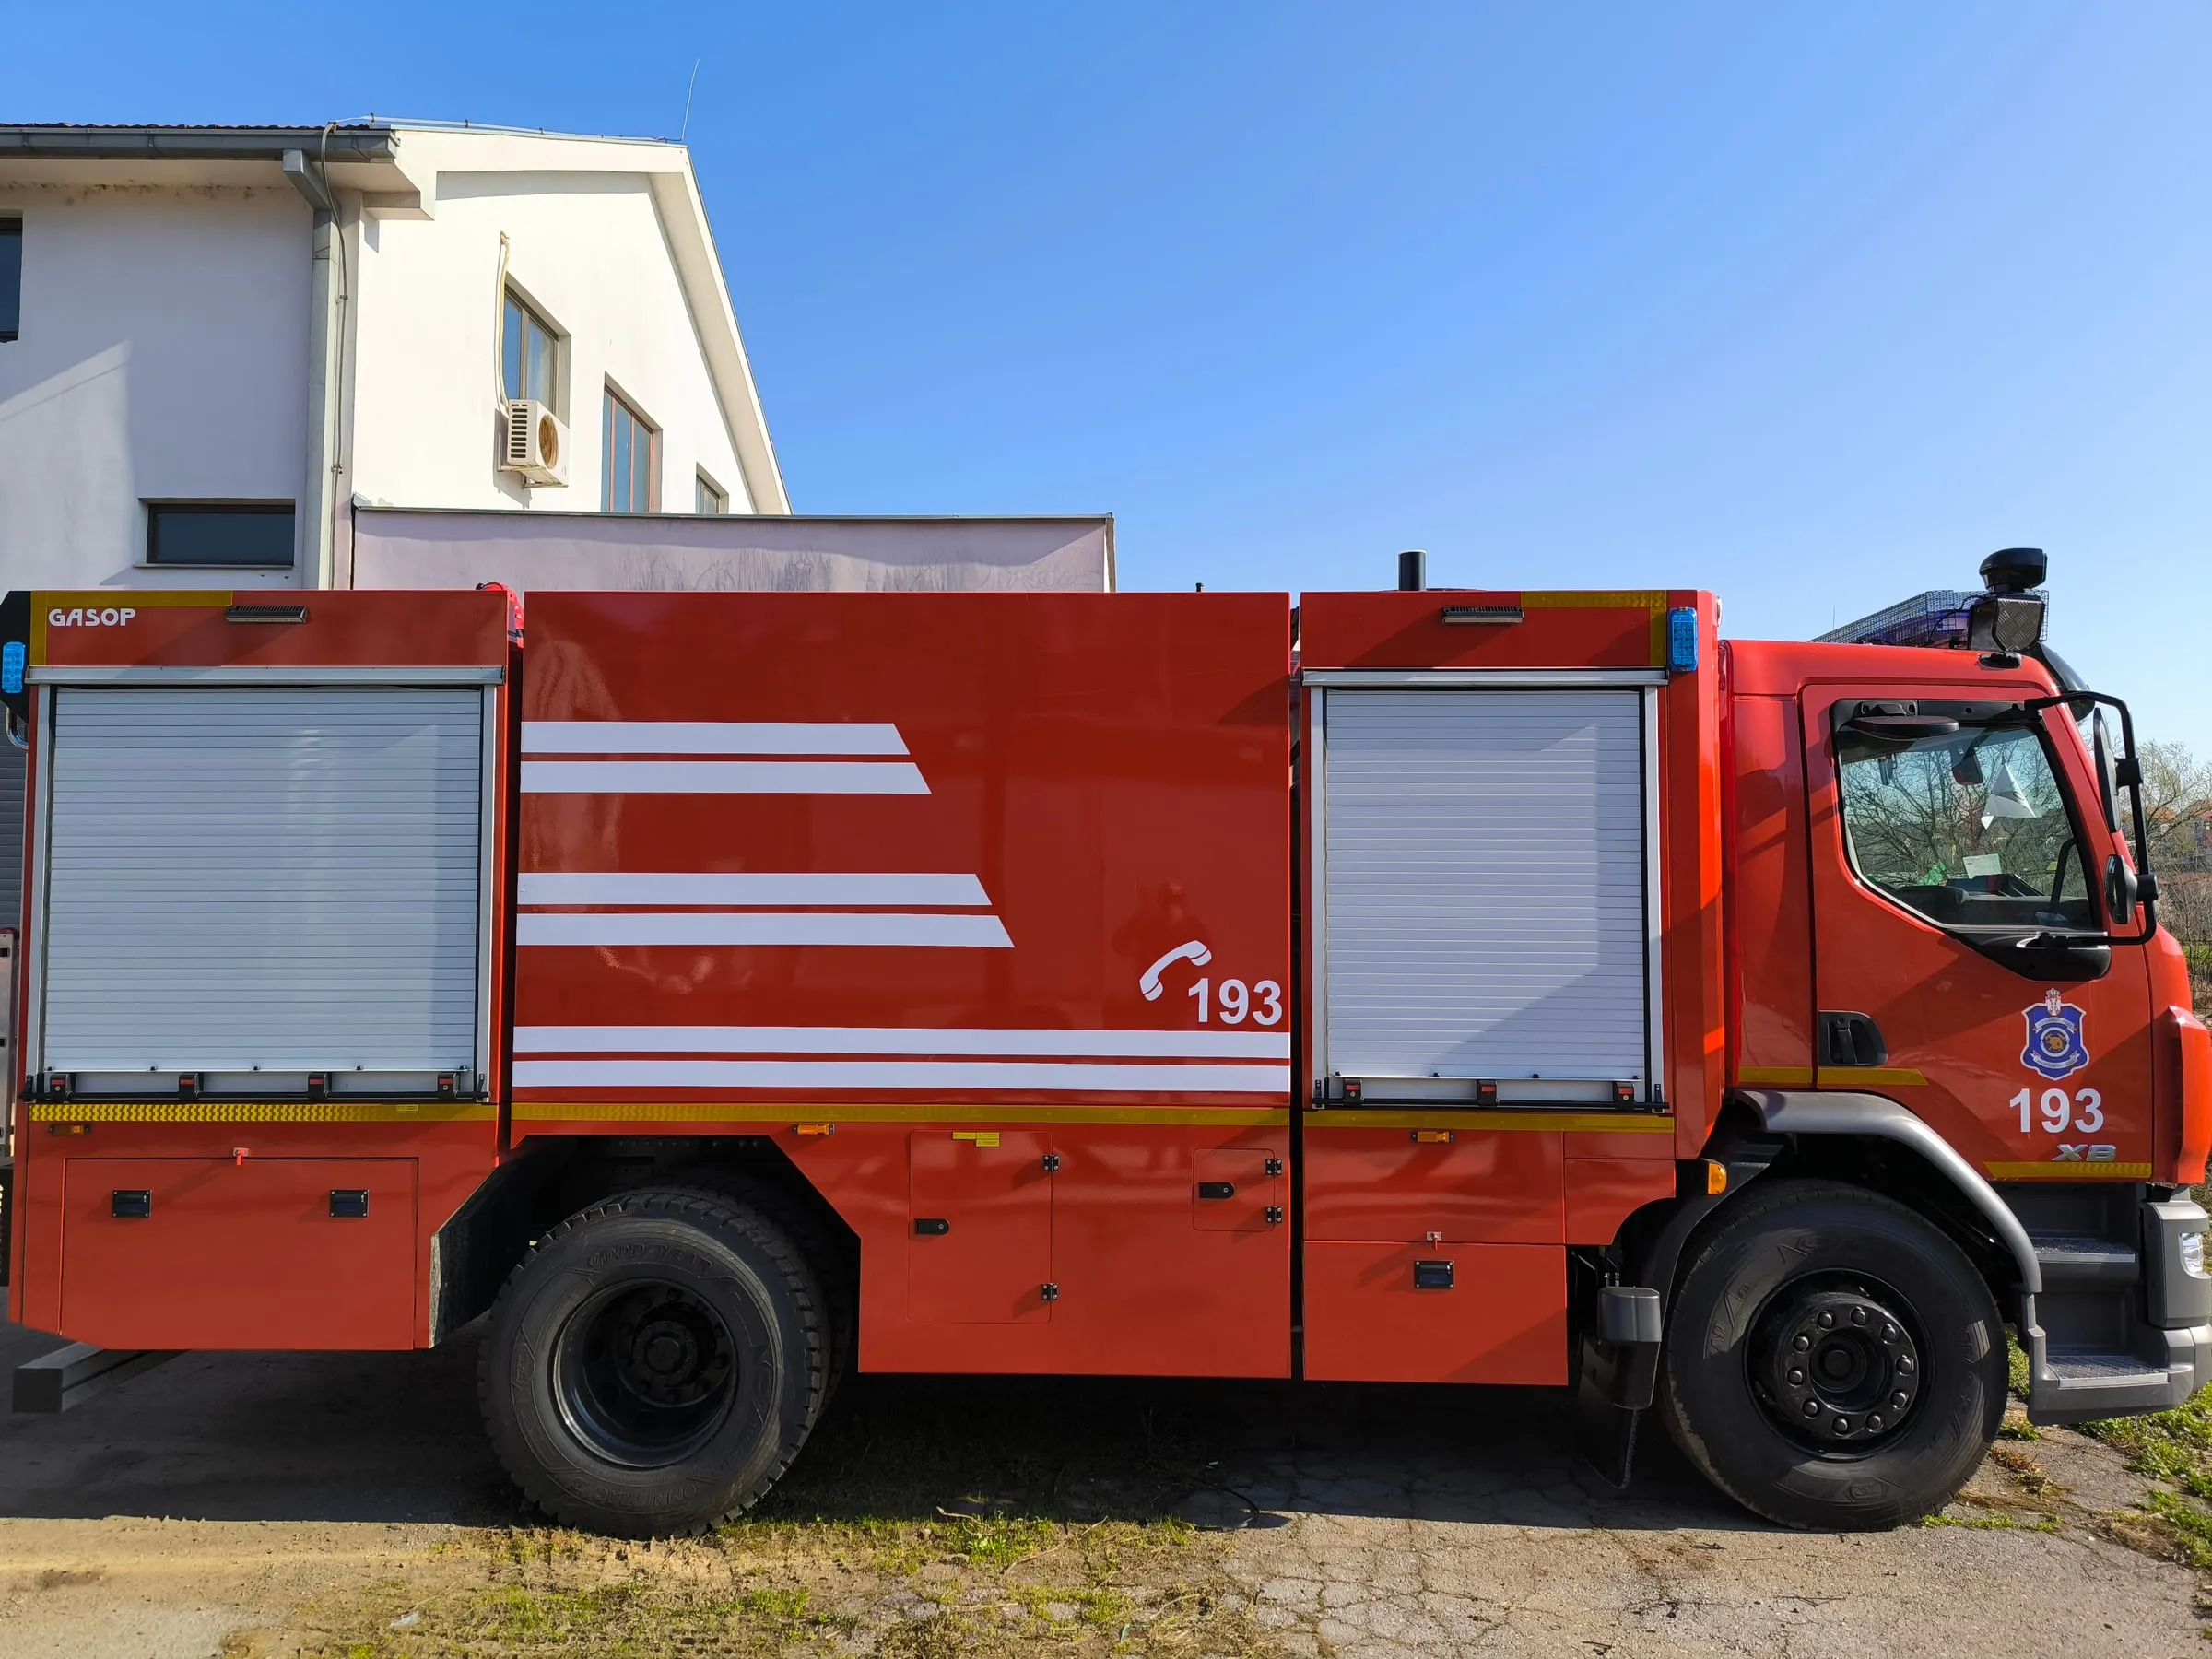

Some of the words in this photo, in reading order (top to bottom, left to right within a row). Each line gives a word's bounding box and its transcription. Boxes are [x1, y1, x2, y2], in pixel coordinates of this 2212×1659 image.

[48, 608, 136, 627] GASOP
[1188, 978, 1283, 1026] 193
[2009, 1088, 2104, 1134] 193
[2052, 1144, 2117, 1162] XB
